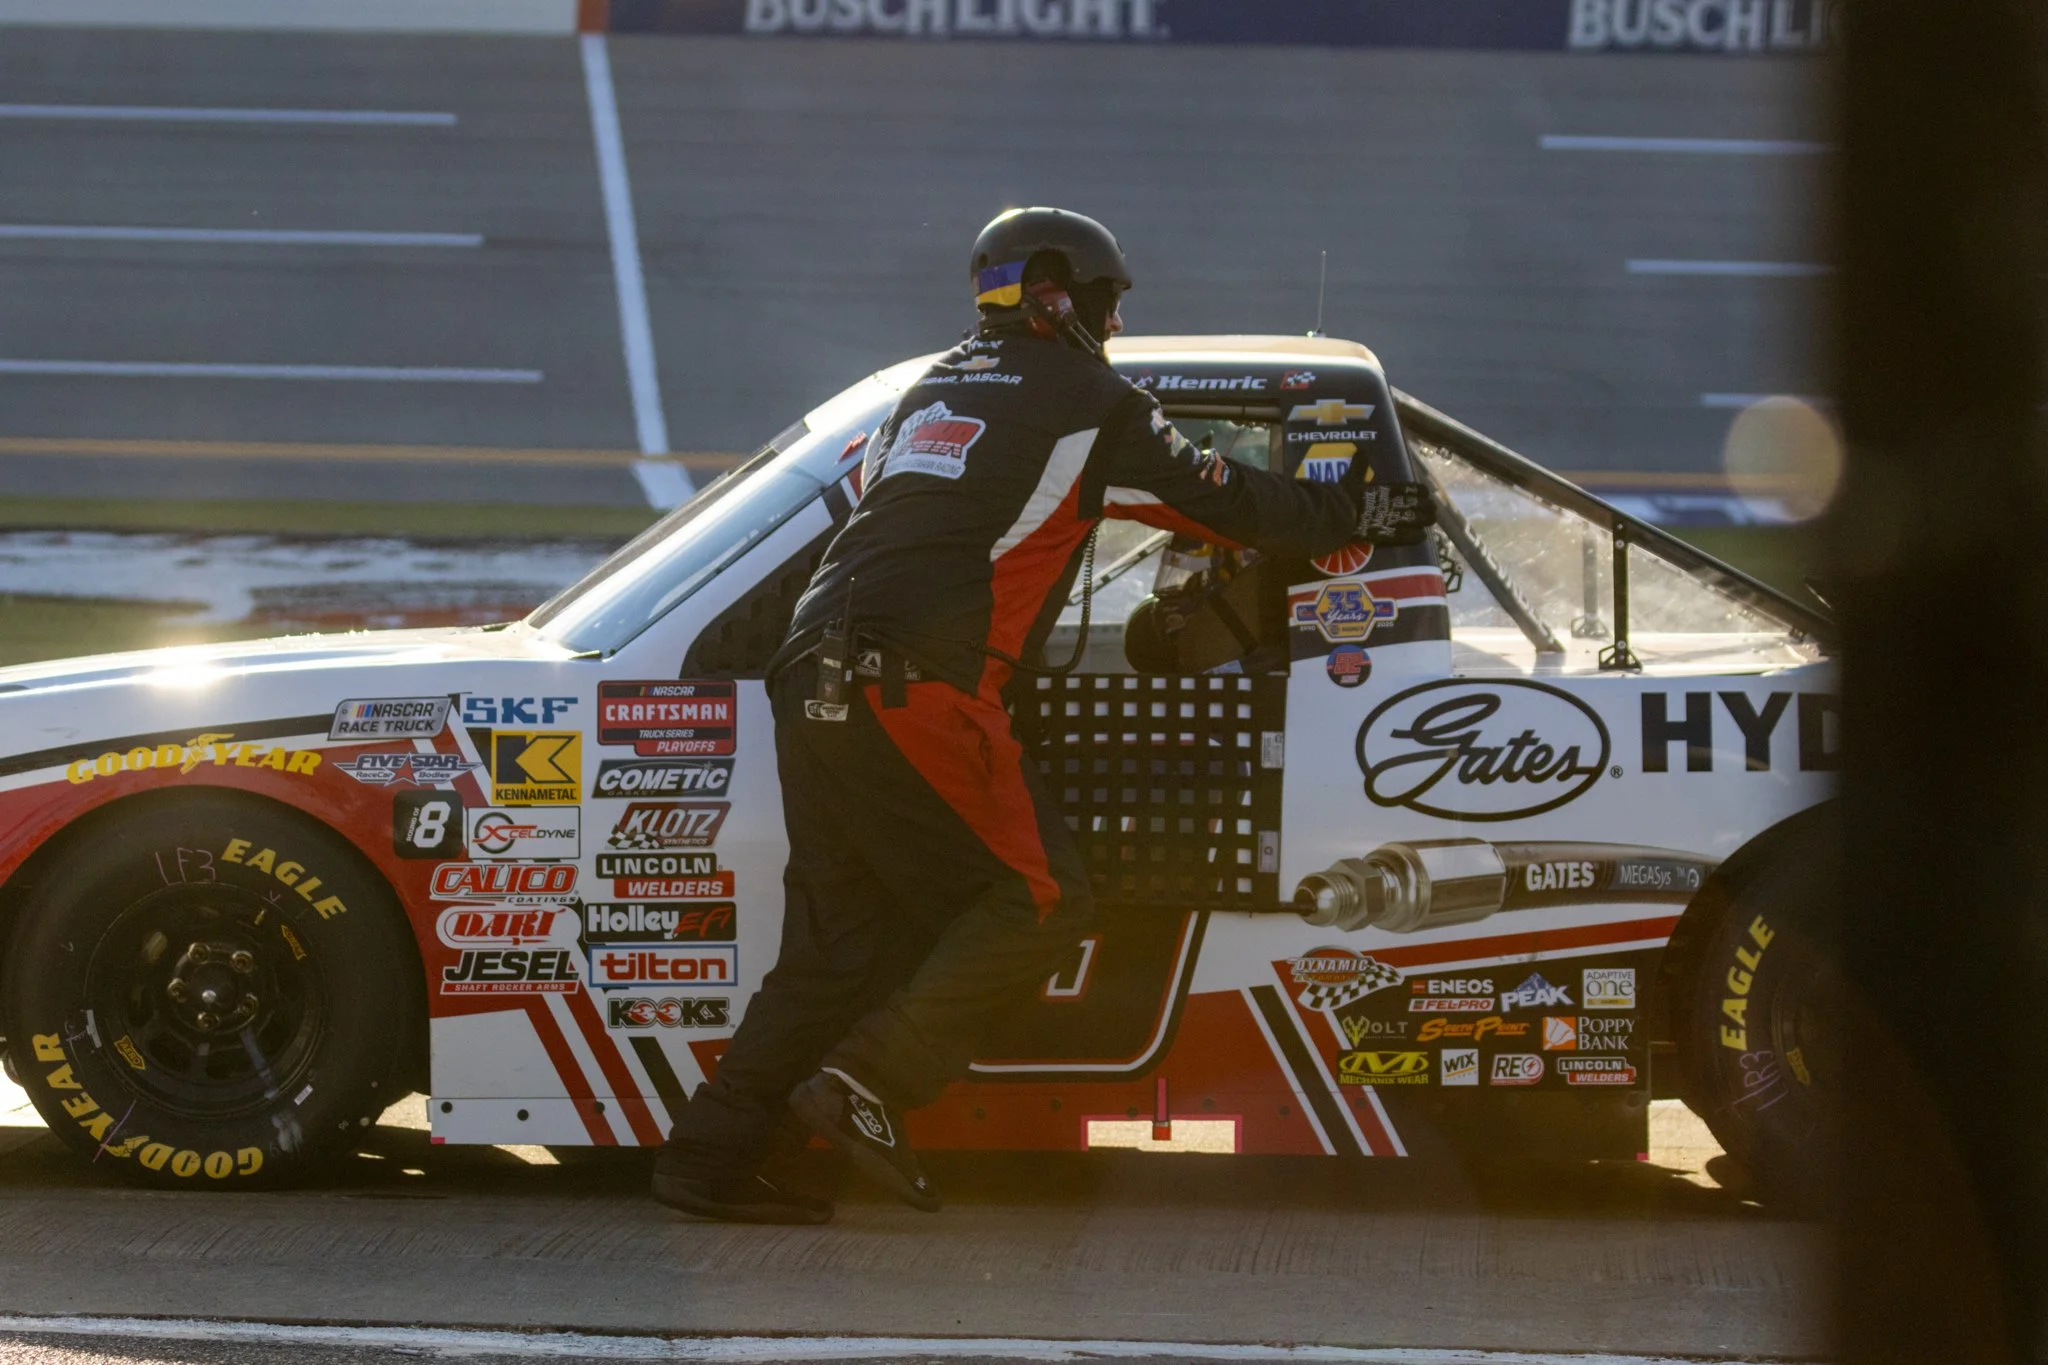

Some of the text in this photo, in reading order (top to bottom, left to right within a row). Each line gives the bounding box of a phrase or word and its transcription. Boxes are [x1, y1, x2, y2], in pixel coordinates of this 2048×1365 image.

[961, 372, 1023, 385] NASCAR
[1156, 375, 1268, 390] Hemric
[1287, 430, 1378, 441] CHEVROLET
[1308, 460, 1349, 483] NAP
[1327, 590, 1361, 611] 35
[652, 686, 695, 697] NASCAR
[371, 702, 435, 718] NASCAR
[463, 696, 578, 724] SKF
[605, 703, 727, 721] CRAFTSMAN
[338, 719, 436, 733] RACE TRUCK
[639, 729, 694, 739] TRUCK SERIES
[656, 740, 716, 752] PLAYOFFS
[1364, 692, 1602, 808] Gates
[356, 754, 460, 769] FIVE STAR
[418, 771, 452, 780] Bodies
[600, 767, 728, 791] COMETIC
[496, 787, 576, 801] KENNAMETAL
[413, 801, 453, 848] 8
[623, 809, 721, 837] KLOTZ
[472, 824, 577, 844] XCELDYNE
[601, 856, 712, 875] LINCOLN
[220, 837, 348, 921] EAGLE
[433, 865, 578, 896] CALICO
[1526, 861, 1595, 891] GATES
[628, 880, 723, 896] WELDERS
[508, 896, 577, 904] COATINGS
[451, 908, 566, 937] DART
[587, 905, 680, 940] Holley
[445, 950, 579, 981] JESEL
[600, 952, 728, 980] tilton
[1295, 959, 1369, 972] DYNAMIC
[1586, 971, 1633, 980] ADAPTIVE
[1720, 914, 1775, 1051] EAGLE
[454, 983, 565, 992] SHAFT ROCKER ARMS
[1427, 978, 1495, 994] ENEOS
[1586, 980, 1634, 997] one
[1500, 984, 1576, 1013] PEAK
[607, 997, 730, 1029] KOOKS
[1577, 1016, 1636, 1034] POPPY
[1577, 1034, 1630, 1050] BANK
[1443, 1052, 1476, 1073] WIX
[1561, 1060, 1623, 1071] LINCOLN
[1398, 1073, 1429, 1085] WEAR
[1576, 1073, 1629, 1082] WELDERS
[31, 1032, 264, 1180] GOODYEAR
